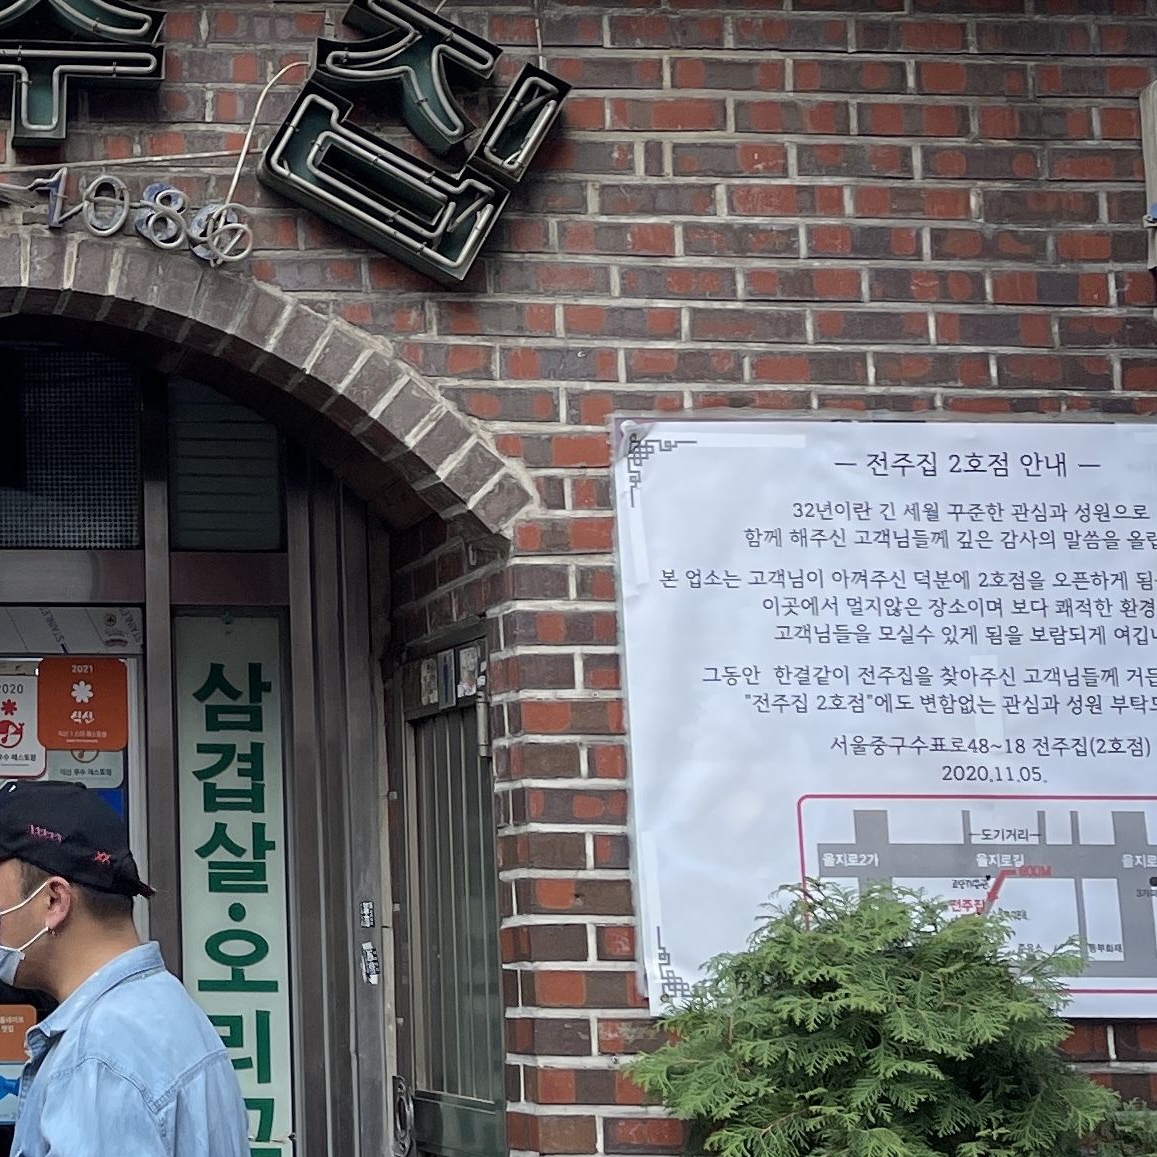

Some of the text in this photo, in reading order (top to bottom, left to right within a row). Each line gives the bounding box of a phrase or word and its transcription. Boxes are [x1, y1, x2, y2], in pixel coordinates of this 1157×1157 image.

[867, 451, 1066, 477] 전주집 2호점 안내
[793, 501, 1150, 523] 32년이란 긴 세월 꾸준한 관심과 성원으로
[744, 528, 782, 547] 함께
[789, 528, 846, 548] 해주신
[854, 528, 949, 549] 고객님들께
[957, 529, 993, 549] 깊은
[1001, 530, 1055, 549] 감사의
[1063, 530, 1120, 550] 말씀을
[659, 569, 1157, 591] 본 업소는 고객님이 아껴주신 덕분에 2호점을 오픈하게 됨
[763, 596, 838, 616] 이곳에서
[846, 596, 922, 617] 멀지않은
[929, 597, 1002, 618] 장소이며
[1011, 598, 1049, 618] 보다
[1055, 598, 1113, 618] 쾌적한
[774, 624, 871, 644] 고객님들을
[878, 624, 935, 644] 모실수
[942, 625, 977, 645] 있게
[985, 625, 1023, 645] 됨을
[1030, 625, 1106, 645] 보람되게
[71, 664, 94, 674] 2021
[702, 665, 761, 686] 그동안
[773, 665, 849, 685] 한결같이
[858, 665, 933, 686] 전주집을
[940, 666, 1016, 687] 찾아주신
[1023, 667, 1119, 687] 고객님들께
[920, 694, 996, 714] 변함없는
[1002, 694, 1060, 715] 관심과
[1067, 695, 1102, 715] 성원
[1033, 736, 1150, 757] 전주집(2호점)
[942, 766, 1047, 783] 2020.11.05.
[981, 829, 1029, 842] 도기거리
[822, 853, 879, 868] 을지로2가
[976, 853, 1025, 868] 을지로길
[949, 899, 986, 914] 전주집
